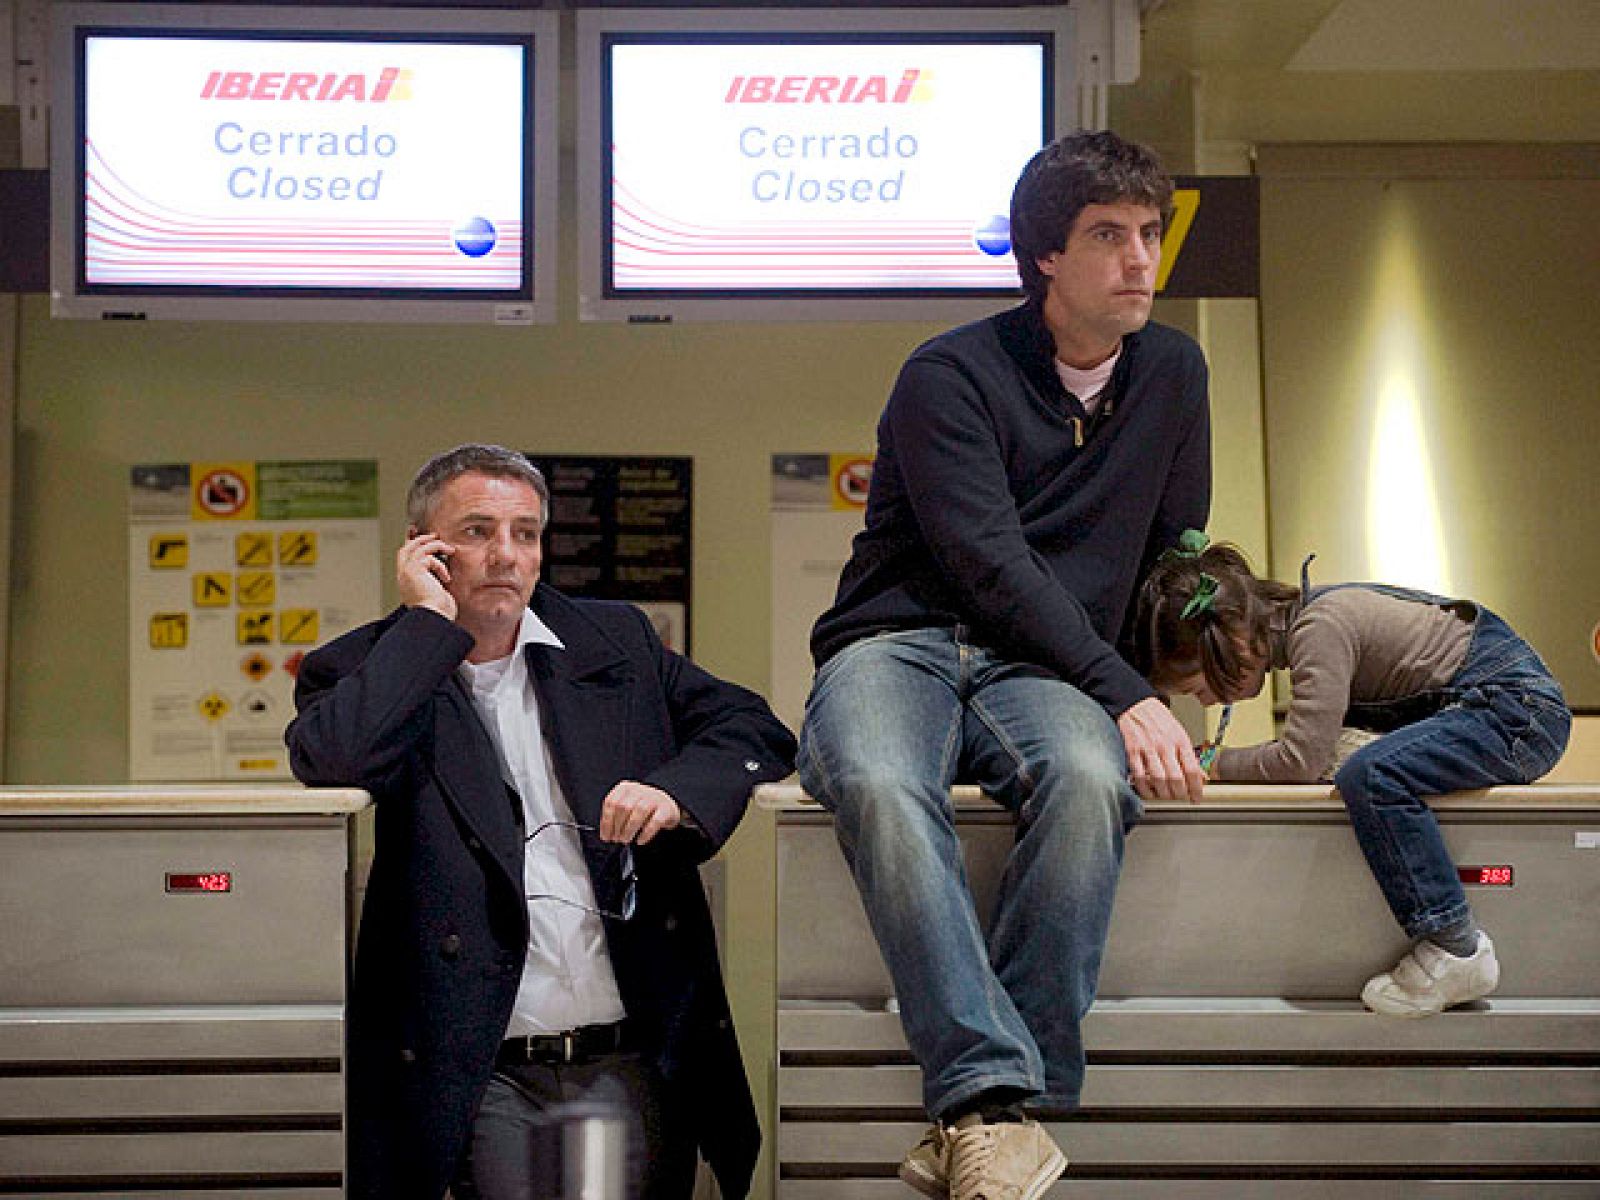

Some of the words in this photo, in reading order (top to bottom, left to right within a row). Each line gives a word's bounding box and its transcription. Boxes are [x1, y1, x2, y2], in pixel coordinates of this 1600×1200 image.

[214, 121, 398, 158] Cerrado
[738, 126, 919, 159] Cerrado
[226, 166, 385, 202] Closed
[751, 170, 906, 203] Closed
